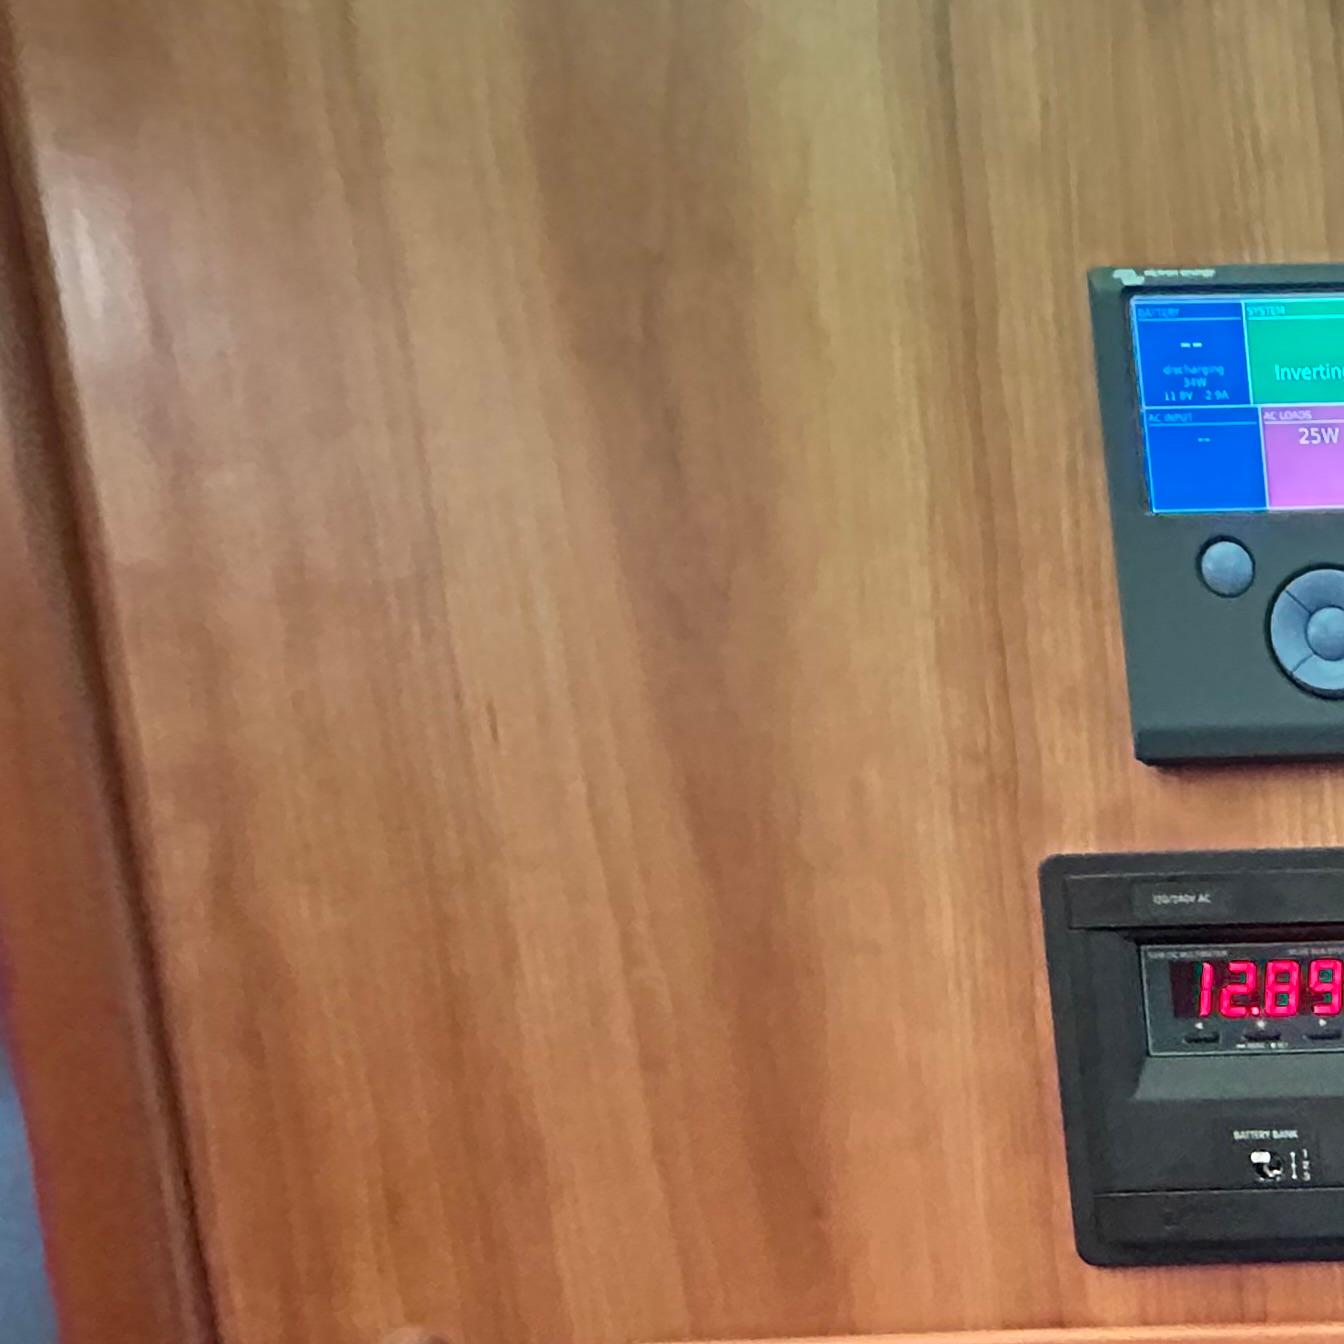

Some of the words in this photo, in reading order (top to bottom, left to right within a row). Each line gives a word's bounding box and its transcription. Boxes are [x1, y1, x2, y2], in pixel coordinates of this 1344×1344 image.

[1264, 412, 1275, 420] AC
[1298, 427, 1339, 445] 25W
[1199, 958, 1344, 1018] 12.89
[1233, 1130, 1271, 1140] BATTERY
[1272, 1130, 1299, 1139] BANK
